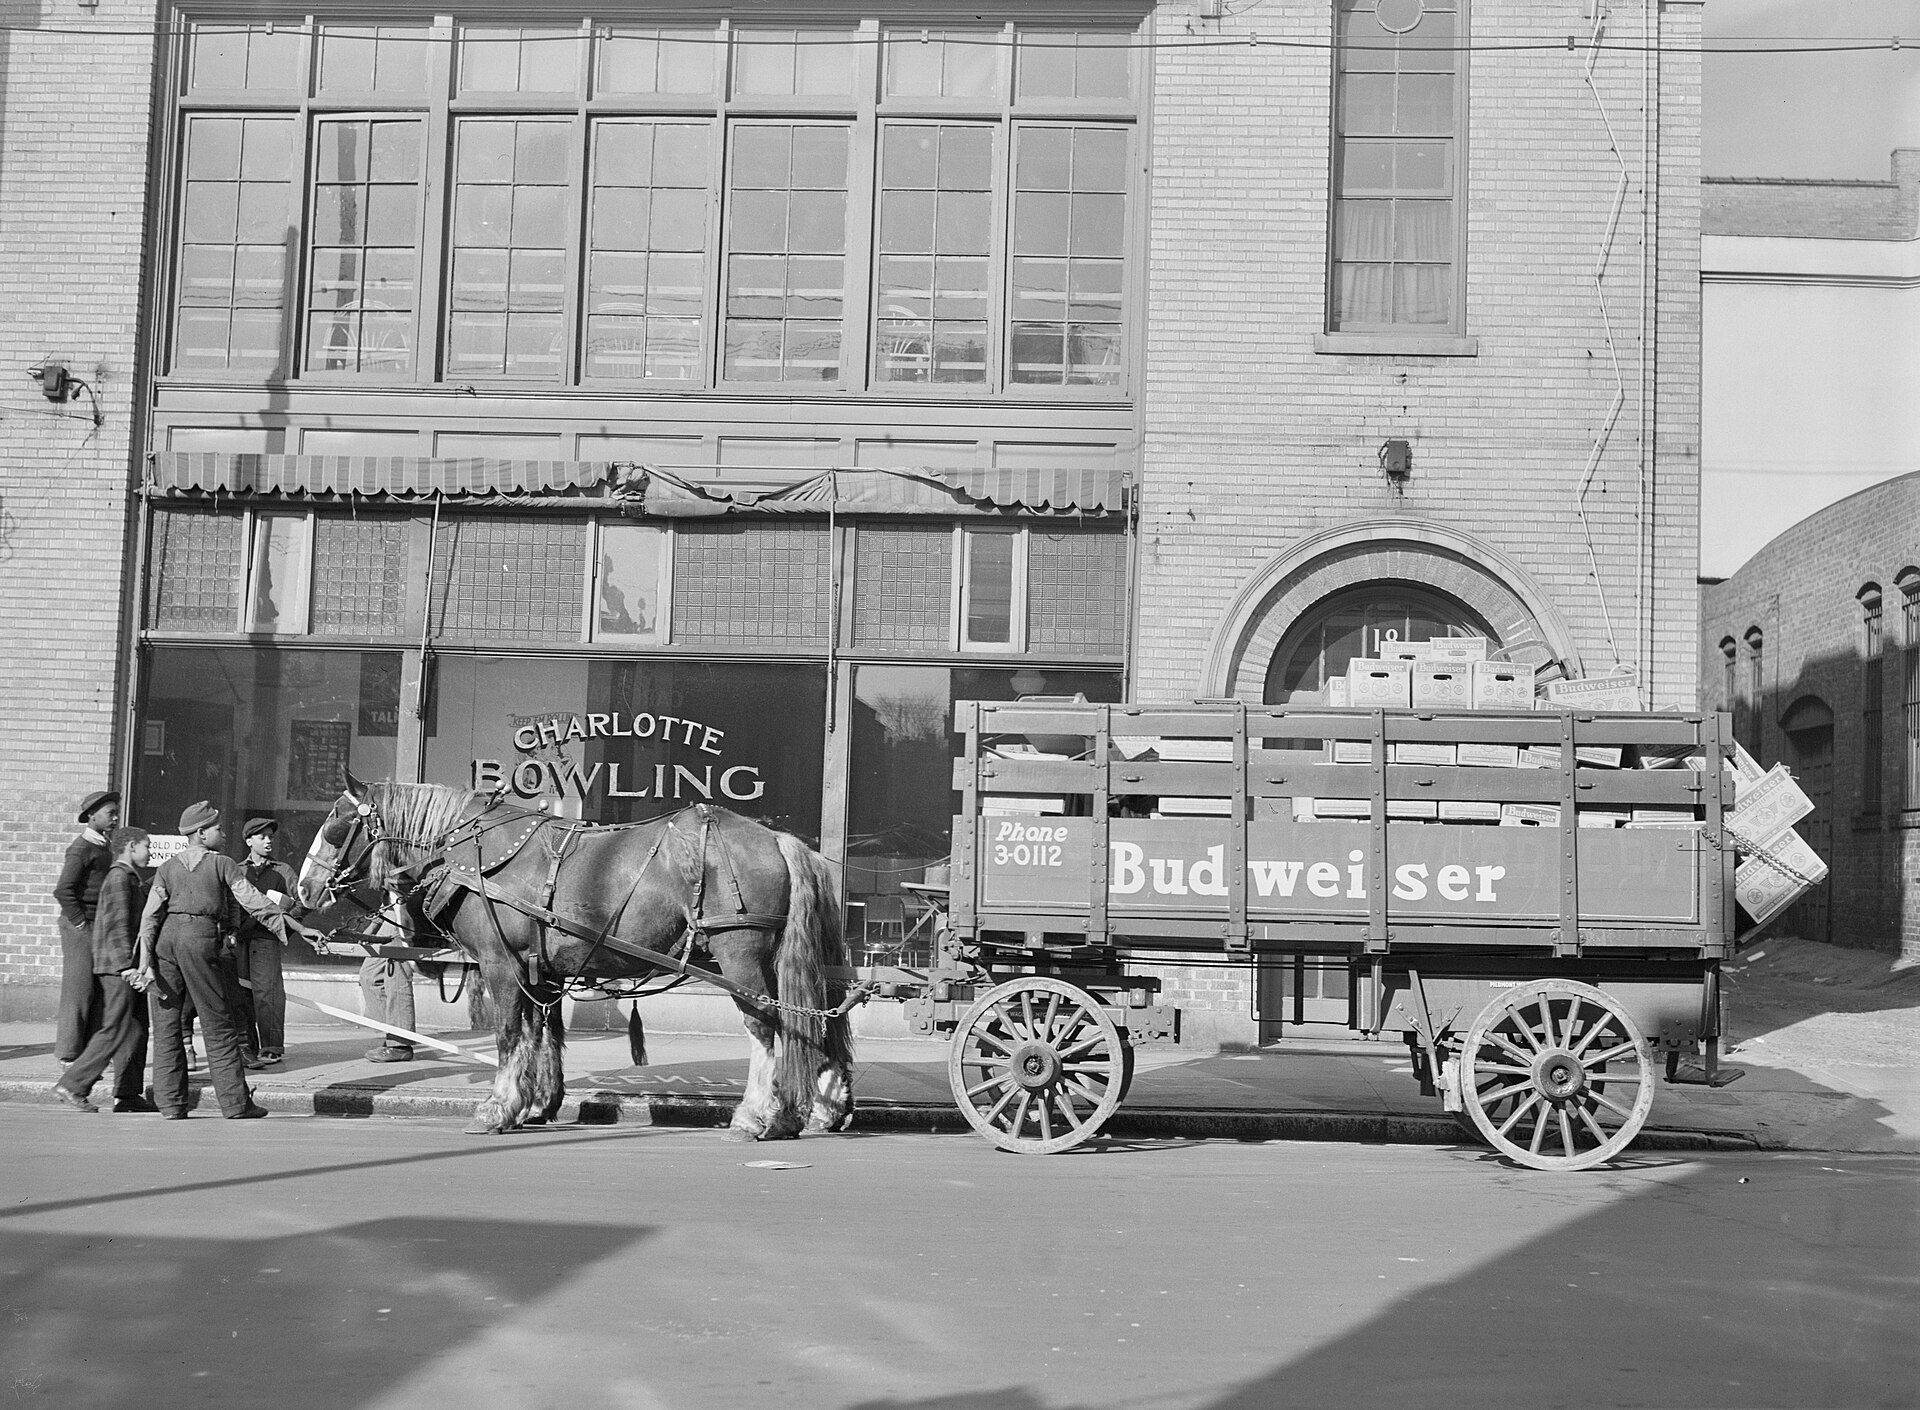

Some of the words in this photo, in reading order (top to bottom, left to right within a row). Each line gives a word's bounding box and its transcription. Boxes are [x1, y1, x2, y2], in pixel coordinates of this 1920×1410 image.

[1436, 640, 1482, 649] Budweiser
[1357, 661, 1405, 671] Budweiser
[1420, 663, 1466, 673] Budweiser
[1483, 663, 1529, 675] Budweiser
[1559, 679, 1632, 693] Budweiser
[512, 711, 725, 756] CHARLOTTE
[1525, 753, 1561, 766] Budweis
[472, 758, 766, 800] BOWLING
[1508, 805, 1556, 821] Budweiser
[995, 821, 1068, 842] Phone
[150, 841, 170, 849] OLD
[994, 844, 1062, 867] 3-0112
[1735, 834, 1792, 886] Budwiser
[1107, 841, 1506, 902] Budweiser
